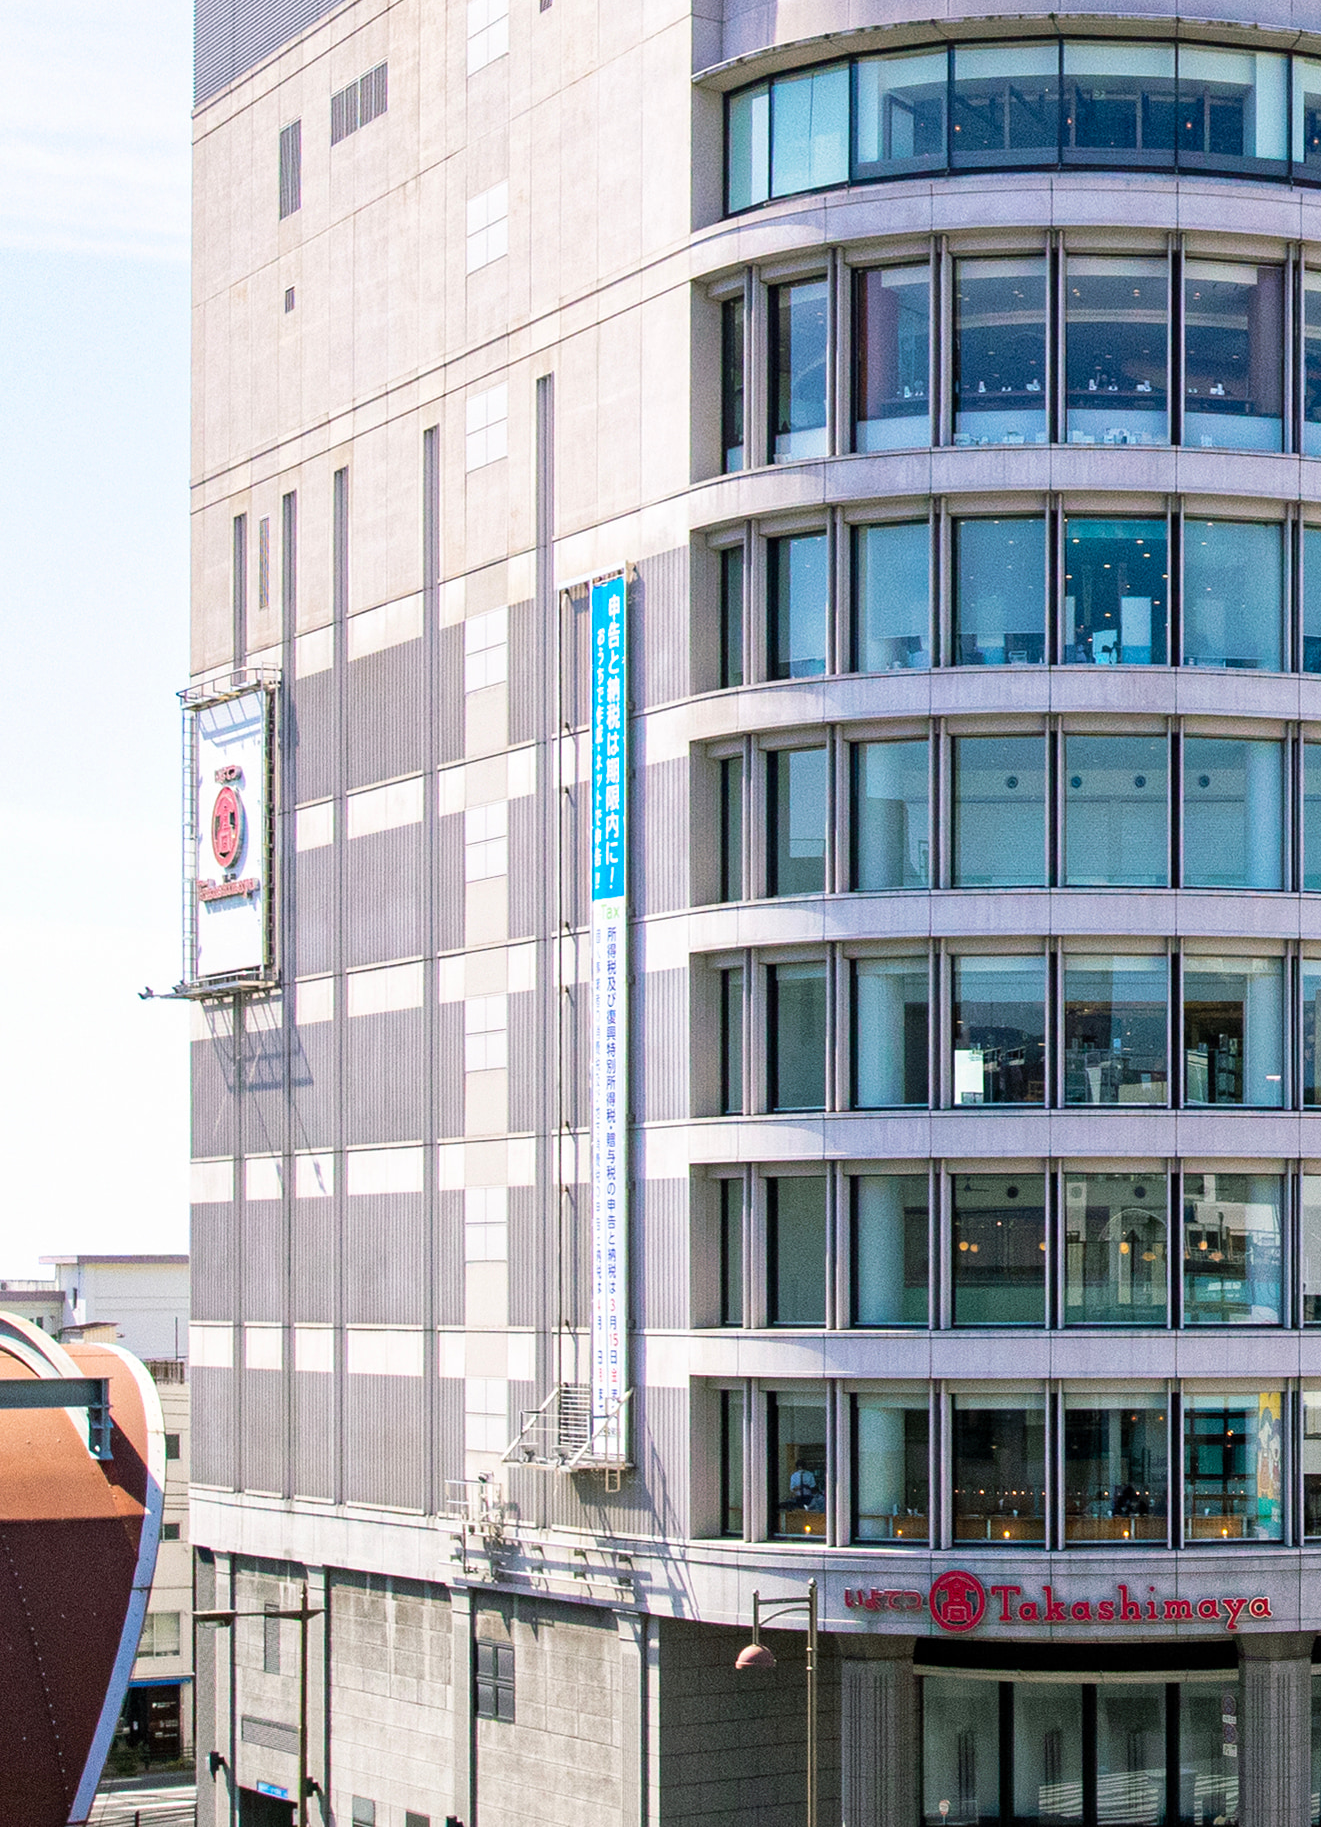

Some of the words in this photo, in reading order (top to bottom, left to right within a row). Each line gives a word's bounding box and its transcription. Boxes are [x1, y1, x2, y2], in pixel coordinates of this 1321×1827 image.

[844, 1587, 924, 1611] いよてつ
[990, 1585, 1273, 1631] Takashimaya
